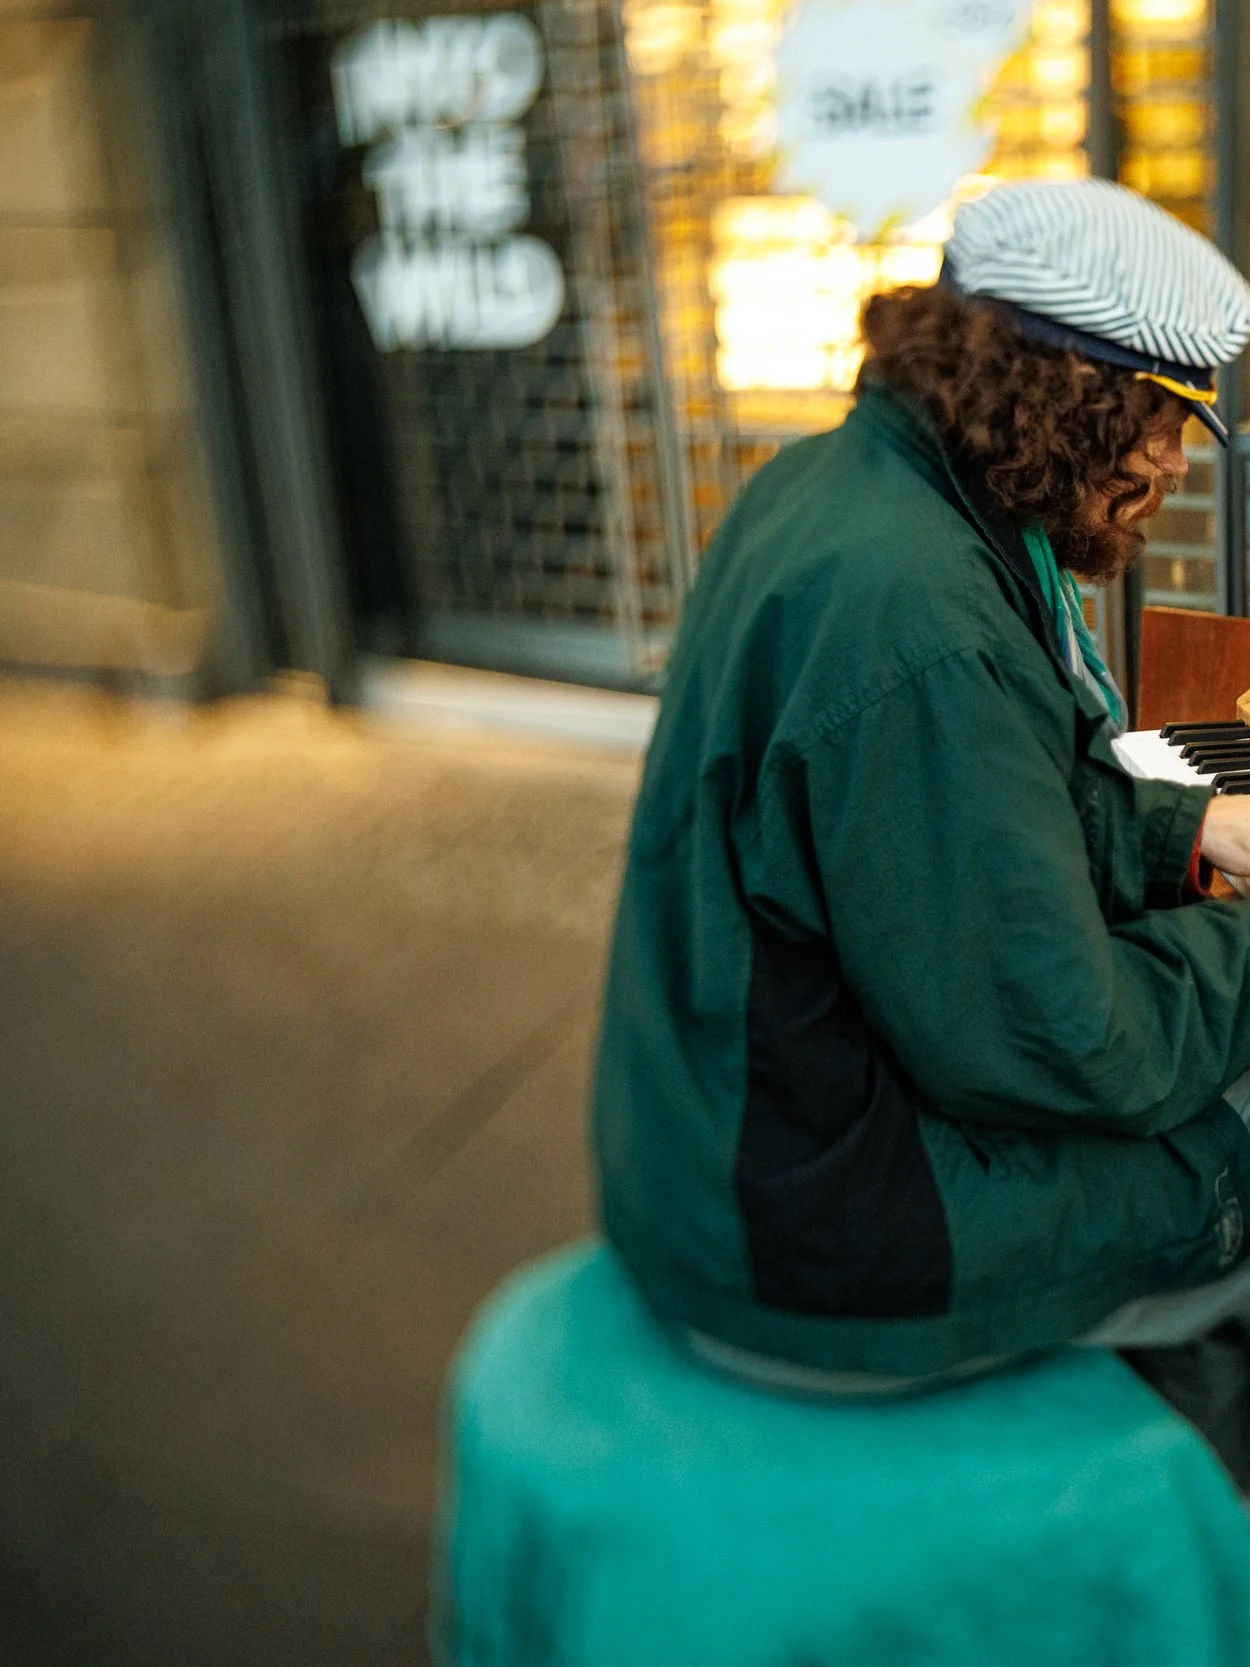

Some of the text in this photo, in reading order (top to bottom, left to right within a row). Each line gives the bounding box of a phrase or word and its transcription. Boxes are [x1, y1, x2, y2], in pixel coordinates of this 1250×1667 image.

[806, 70, 938, 136] SALE
[361, 124, 530, 236] THE
[352, 234, 564, 352] WILD
